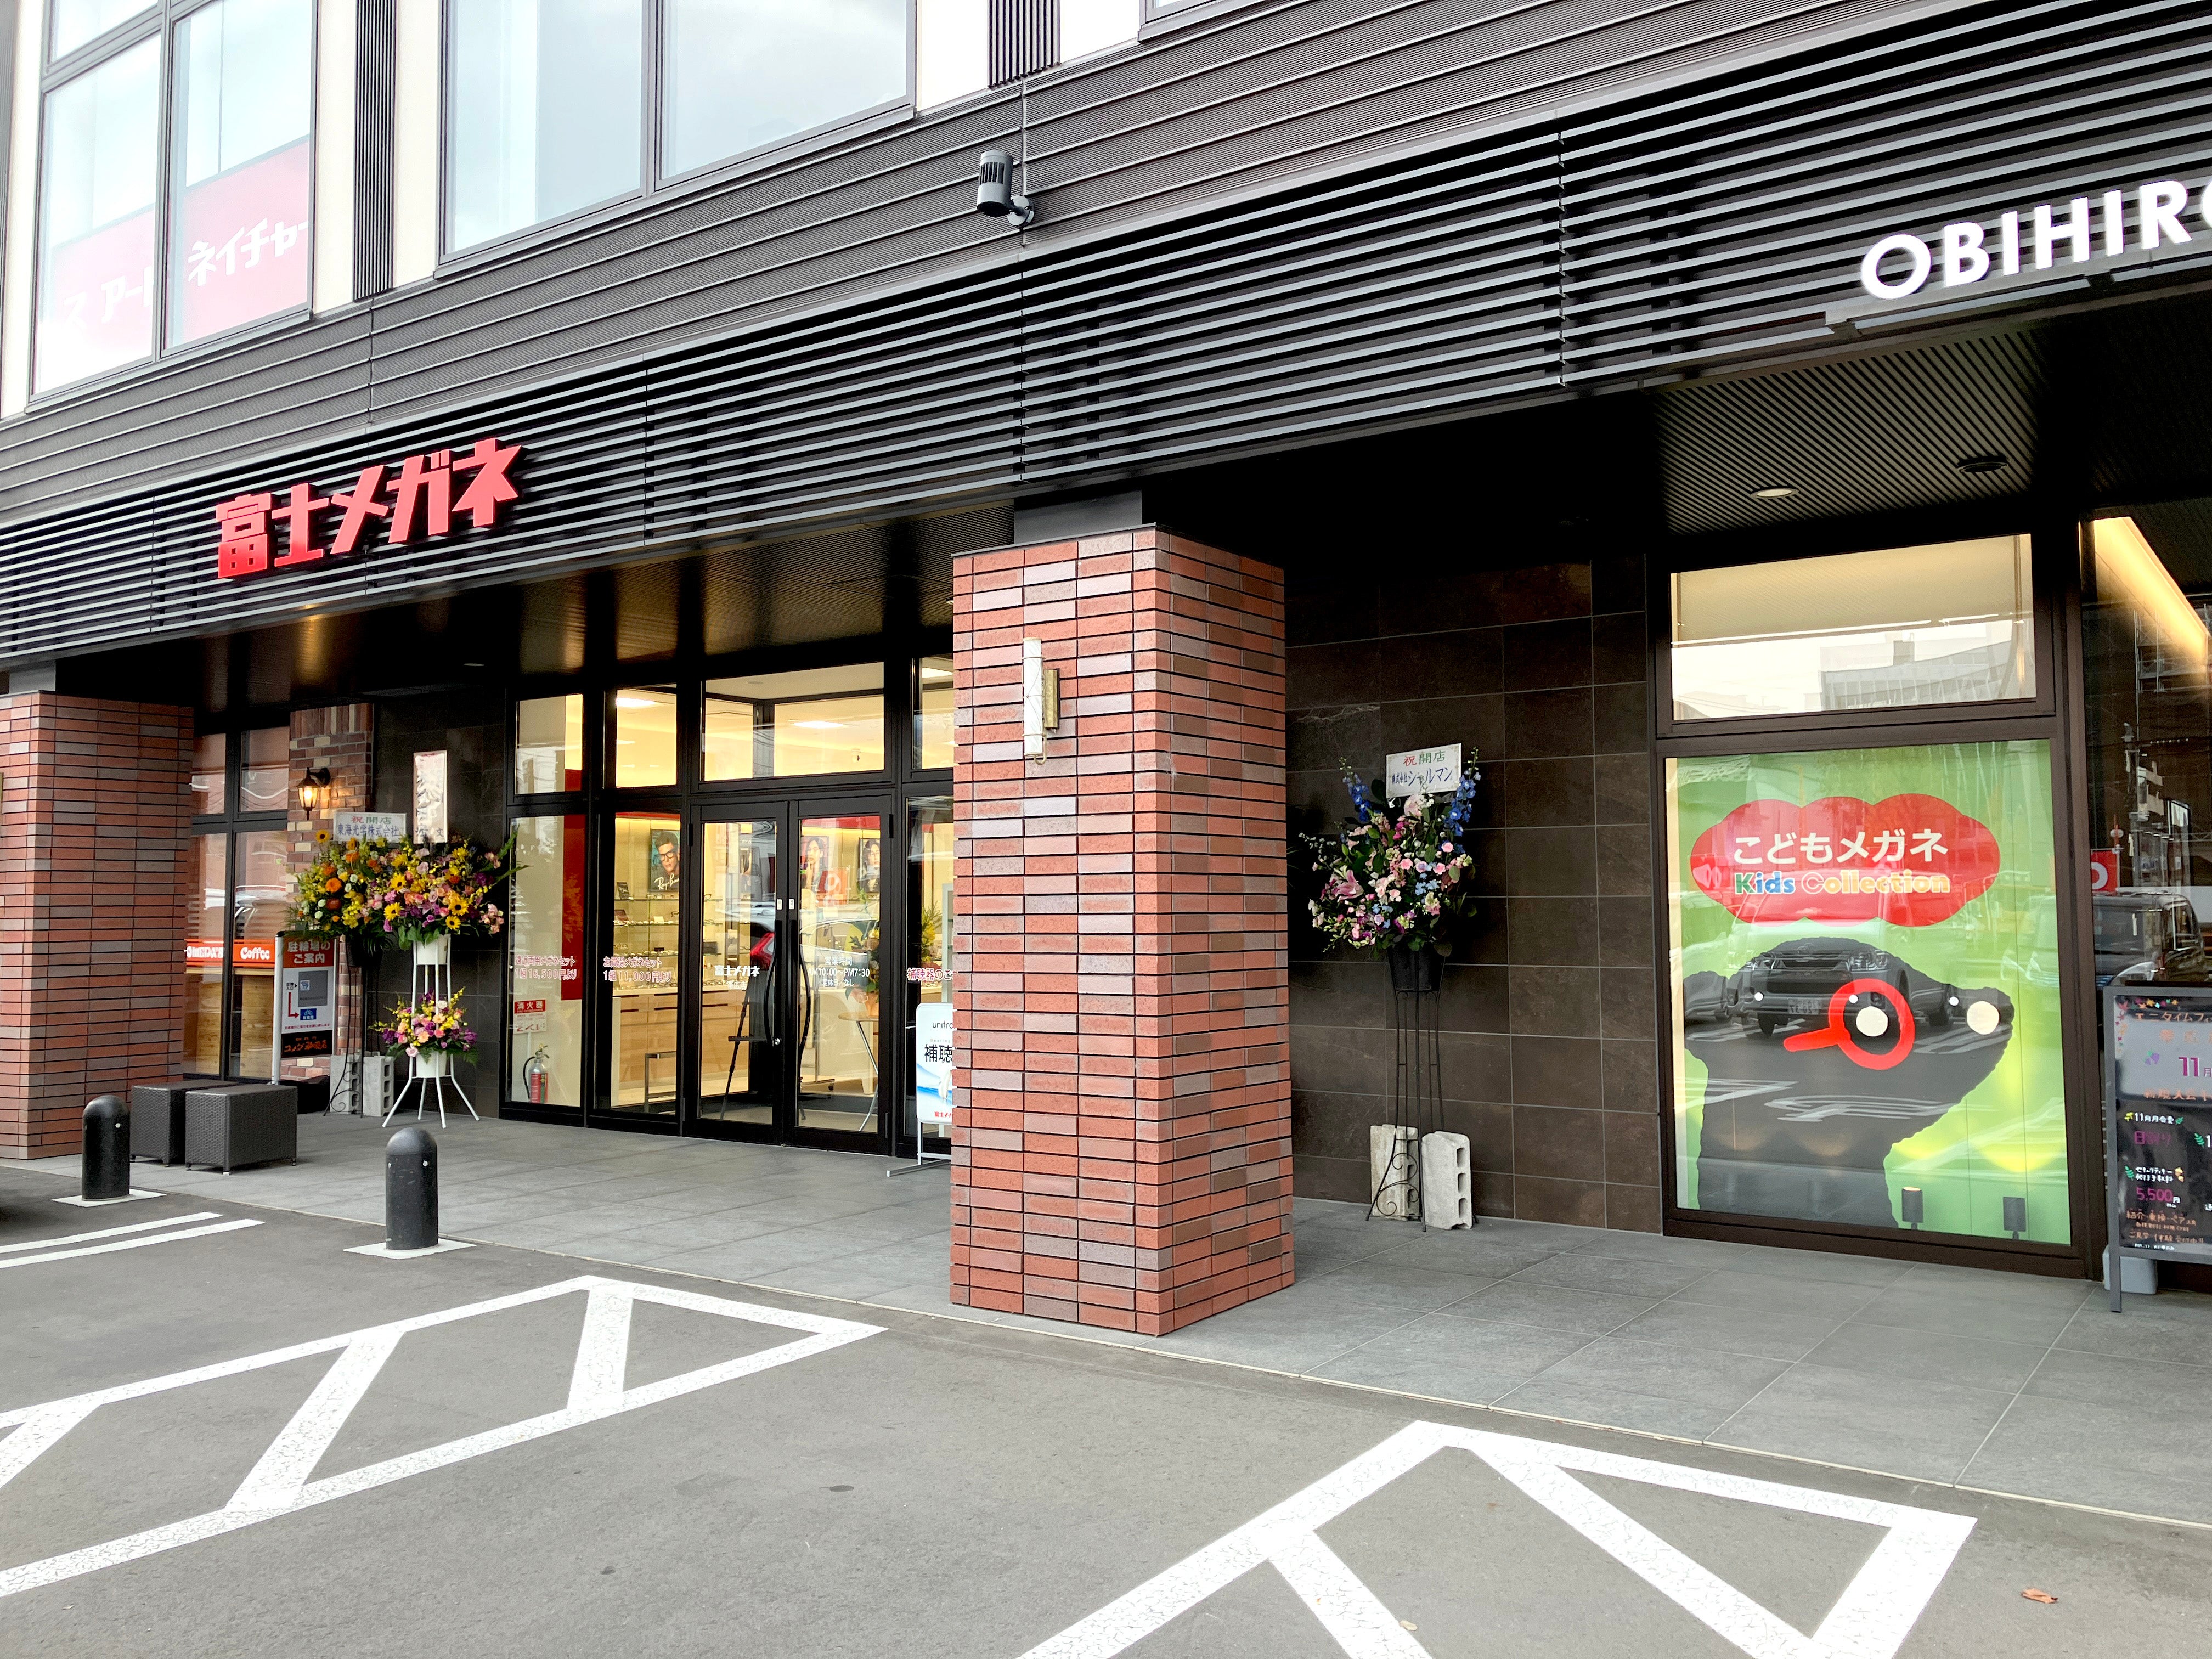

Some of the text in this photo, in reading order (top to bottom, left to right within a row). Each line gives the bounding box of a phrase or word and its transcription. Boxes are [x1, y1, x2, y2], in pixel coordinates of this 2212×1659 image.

[216, 437, 522, 579] 富士メガネ
[337, 823, 399, 837] 東海光学株式会社
[1734, 828, 1949, 865] こどもメガネ
[654, 873, 680, 890] Ray-Ban
[1734, 870, 1951, 895] Kids Collection
[240, 946, 270, 960] Coffee
[294, 952, 325, 964] ご案内
[825, 956, 853, 966] 営業時間
[714, 965, 760, 977] 富士メガネ
[517, 1000, 543, 1011] 消火器
